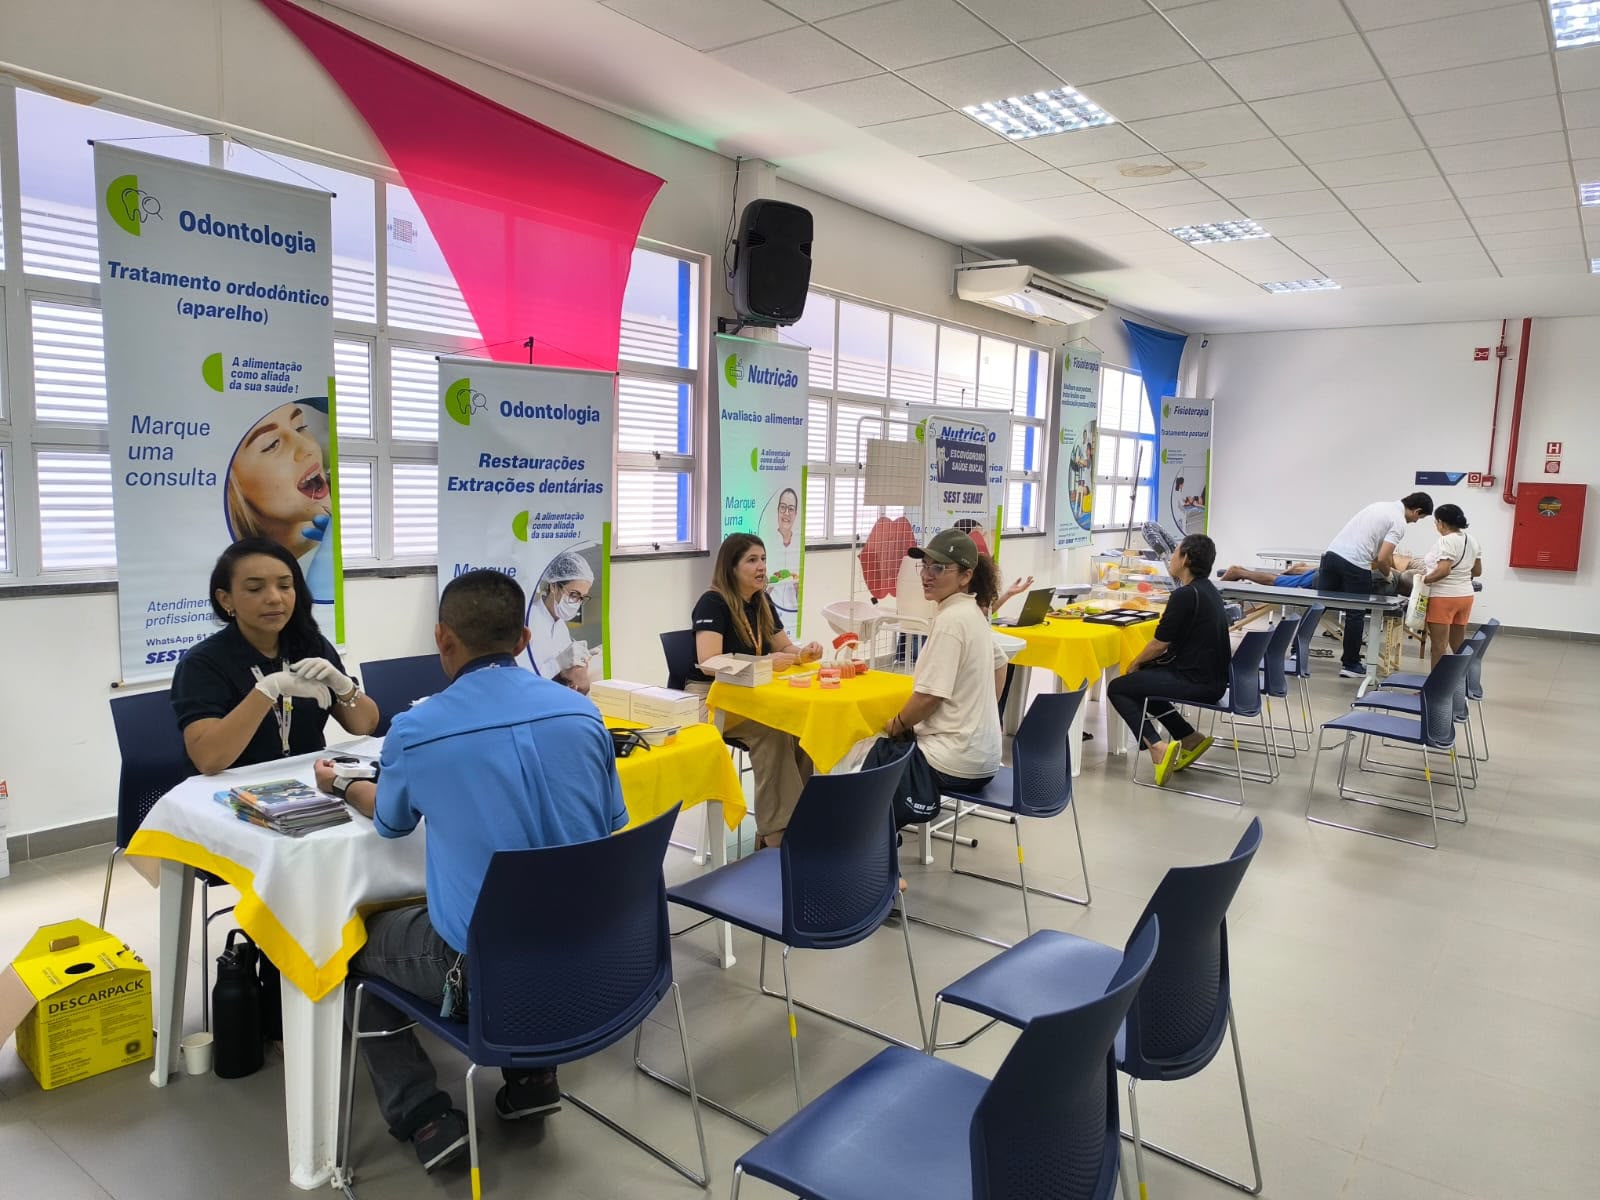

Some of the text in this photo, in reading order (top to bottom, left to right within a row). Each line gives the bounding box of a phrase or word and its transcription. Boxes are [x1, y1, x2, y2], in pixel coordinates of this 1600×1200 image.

[179, 210, 316, 254] Odontologia
[108, 261, 330, 307] Tratamento ordodôntico
[177, 298, 269, 325] (aparelho)
[232, 357, 303, 373] A alimentação
[230, 371, 290, 382] como aliada
[748, 364, 798, 388] Nutrição
[229, 380, 243, 390] da
[244, 382, 262, 392] sua
[264, 382, 293, 393] saúde
[500, 401, 600, 425] Odontologia
[765, 412, 803, 426] alimentar
[1173, 405, 1209, 418] Fisioterapia
[131, 415, 211, 440] Marque
[128, 445, 174, 461] uma
[1548, 443, 1560, 454] H
[478, 453, 585, 473] Restaurações
[125, 467, 217, 487] consulta
[447, 476, 603, 495] Extrações dentárias
[725, 496, 756, 511] Marque
[943, 490, 961, 504] SEST
[534, 512, 585, 522] A alimentação
[725, 516, 743, 526] uma
[553, 521, 575, 530] aliada
[555, 530, 577, 539] saúde
[147, 597, 212, 612] Atendimen
[145, 611, 215, 629] profissiona
[146, 636, 194, 646] WhatsApp
[145, 648, 189, 664] SEST
[48, 978, 144, 1015] DESCARPACK
